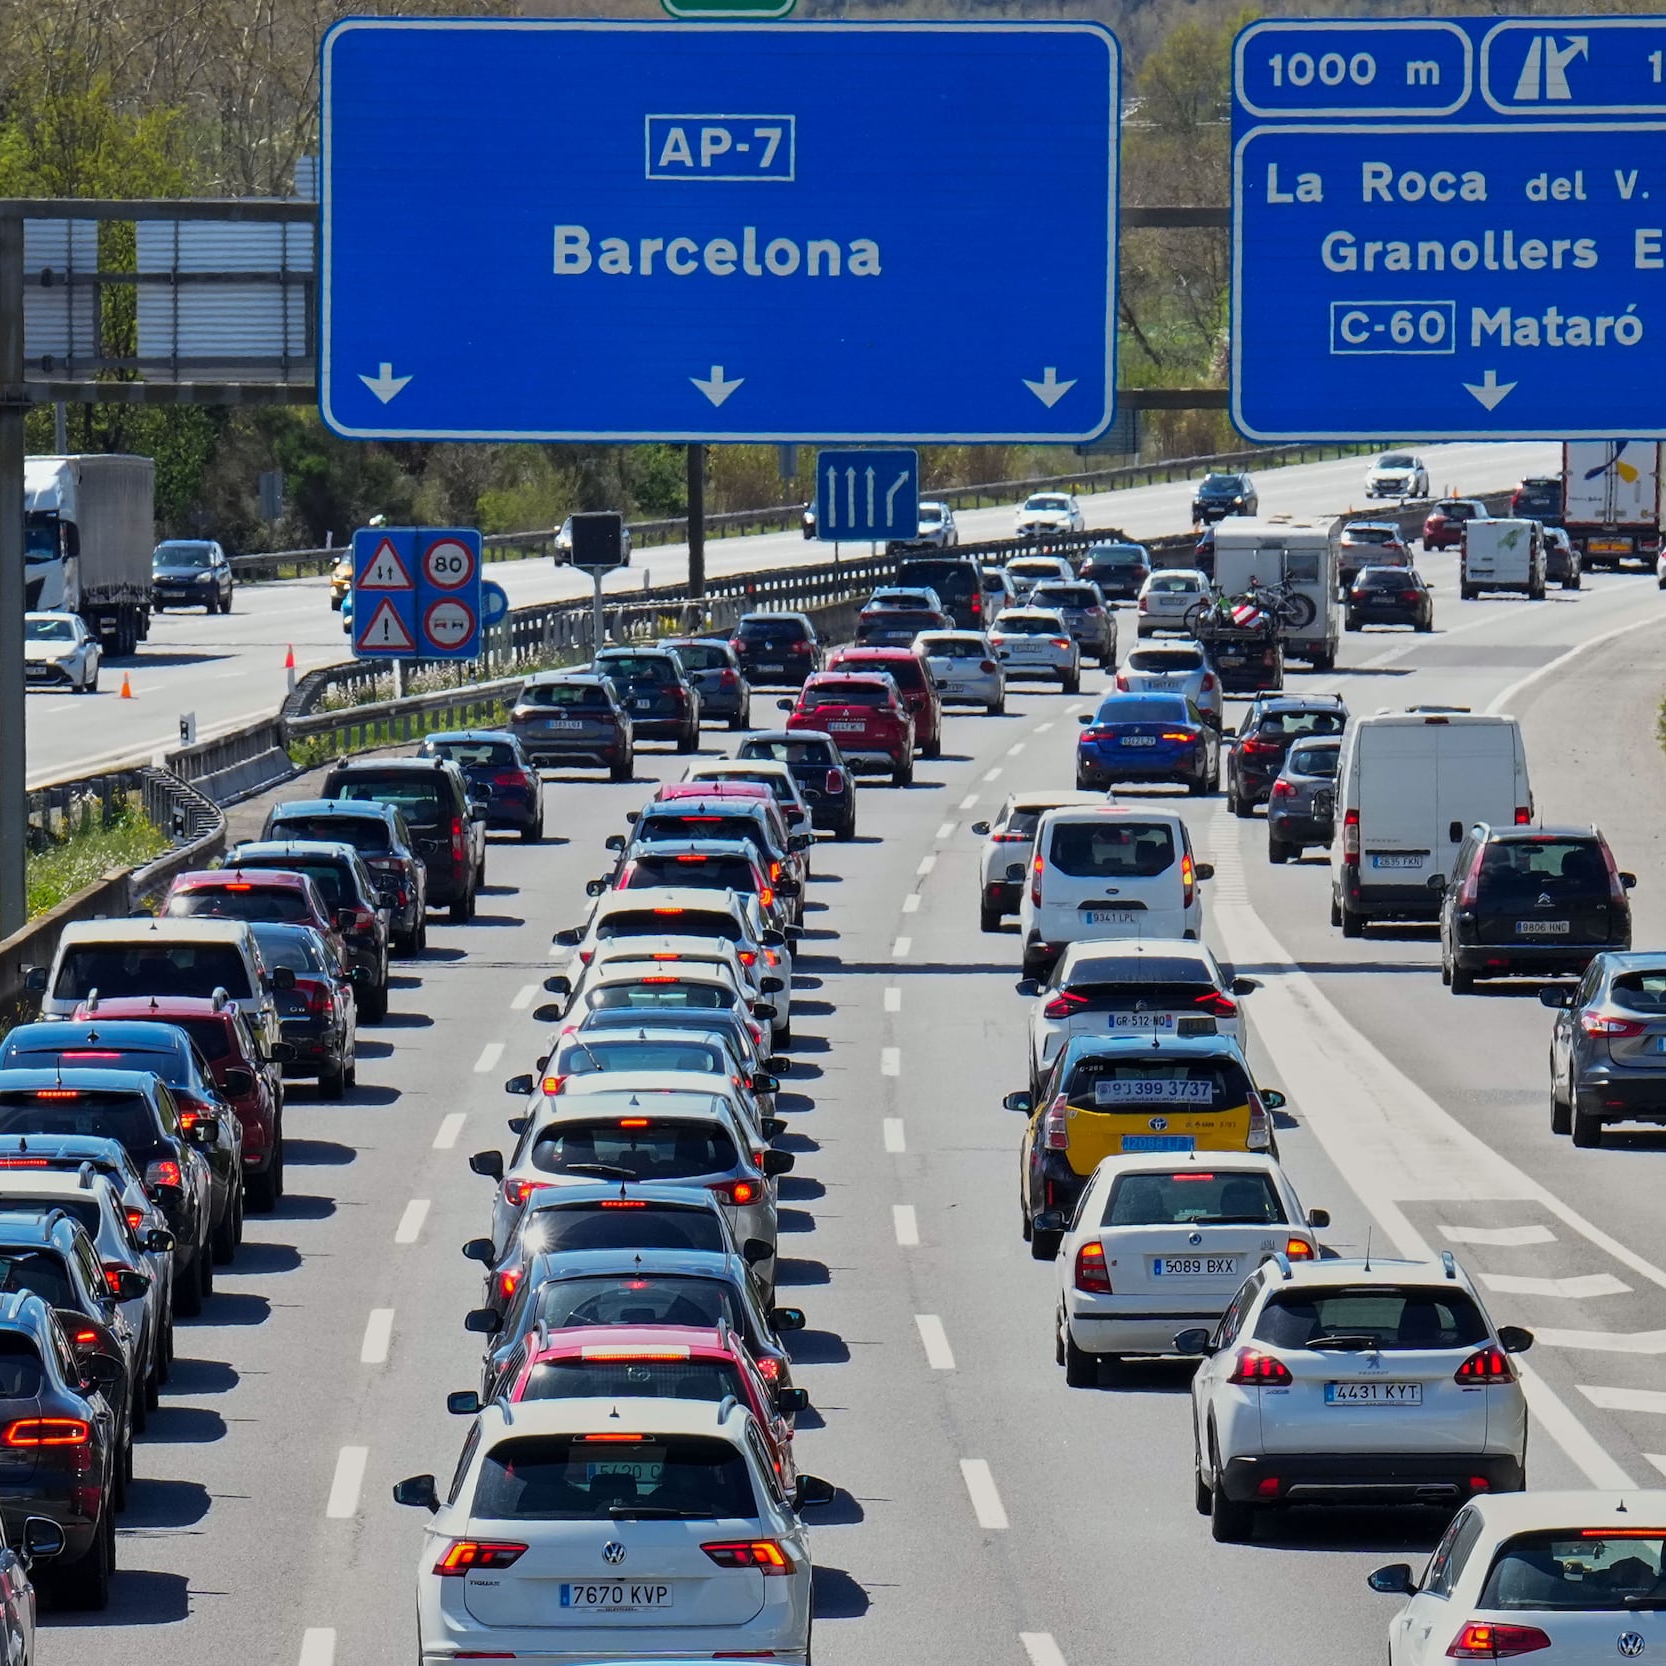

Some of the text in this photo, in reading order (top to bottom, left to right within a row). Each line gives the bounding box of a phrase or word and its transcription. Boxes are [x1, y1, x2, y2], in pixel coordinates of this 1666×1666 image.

[1268, 53, 1441, 87] 1000 m
[658, 127, 783, 168] AP-7
[1266, 162, 1649, 205] La Roca del V.
[554, 225, 882, 278] Barcelona
[1321, 230, 1664, 274] Granollers E
[1340, 304, 1642, 348] C-60 Mataró
[435, 557, 462, 573] 80
[1523, 923, 1546, 932] 9806
[1135, 1082, 1164, 1095] 399
[1168, 1081, 1210, 1097] 3737
[1166, 1259, 1234, 1273] 5089 BXX
[1337, 1384, 1418, 1398] 4431 KYT
[573, 1587, 668, 1604] 7670 KVP
